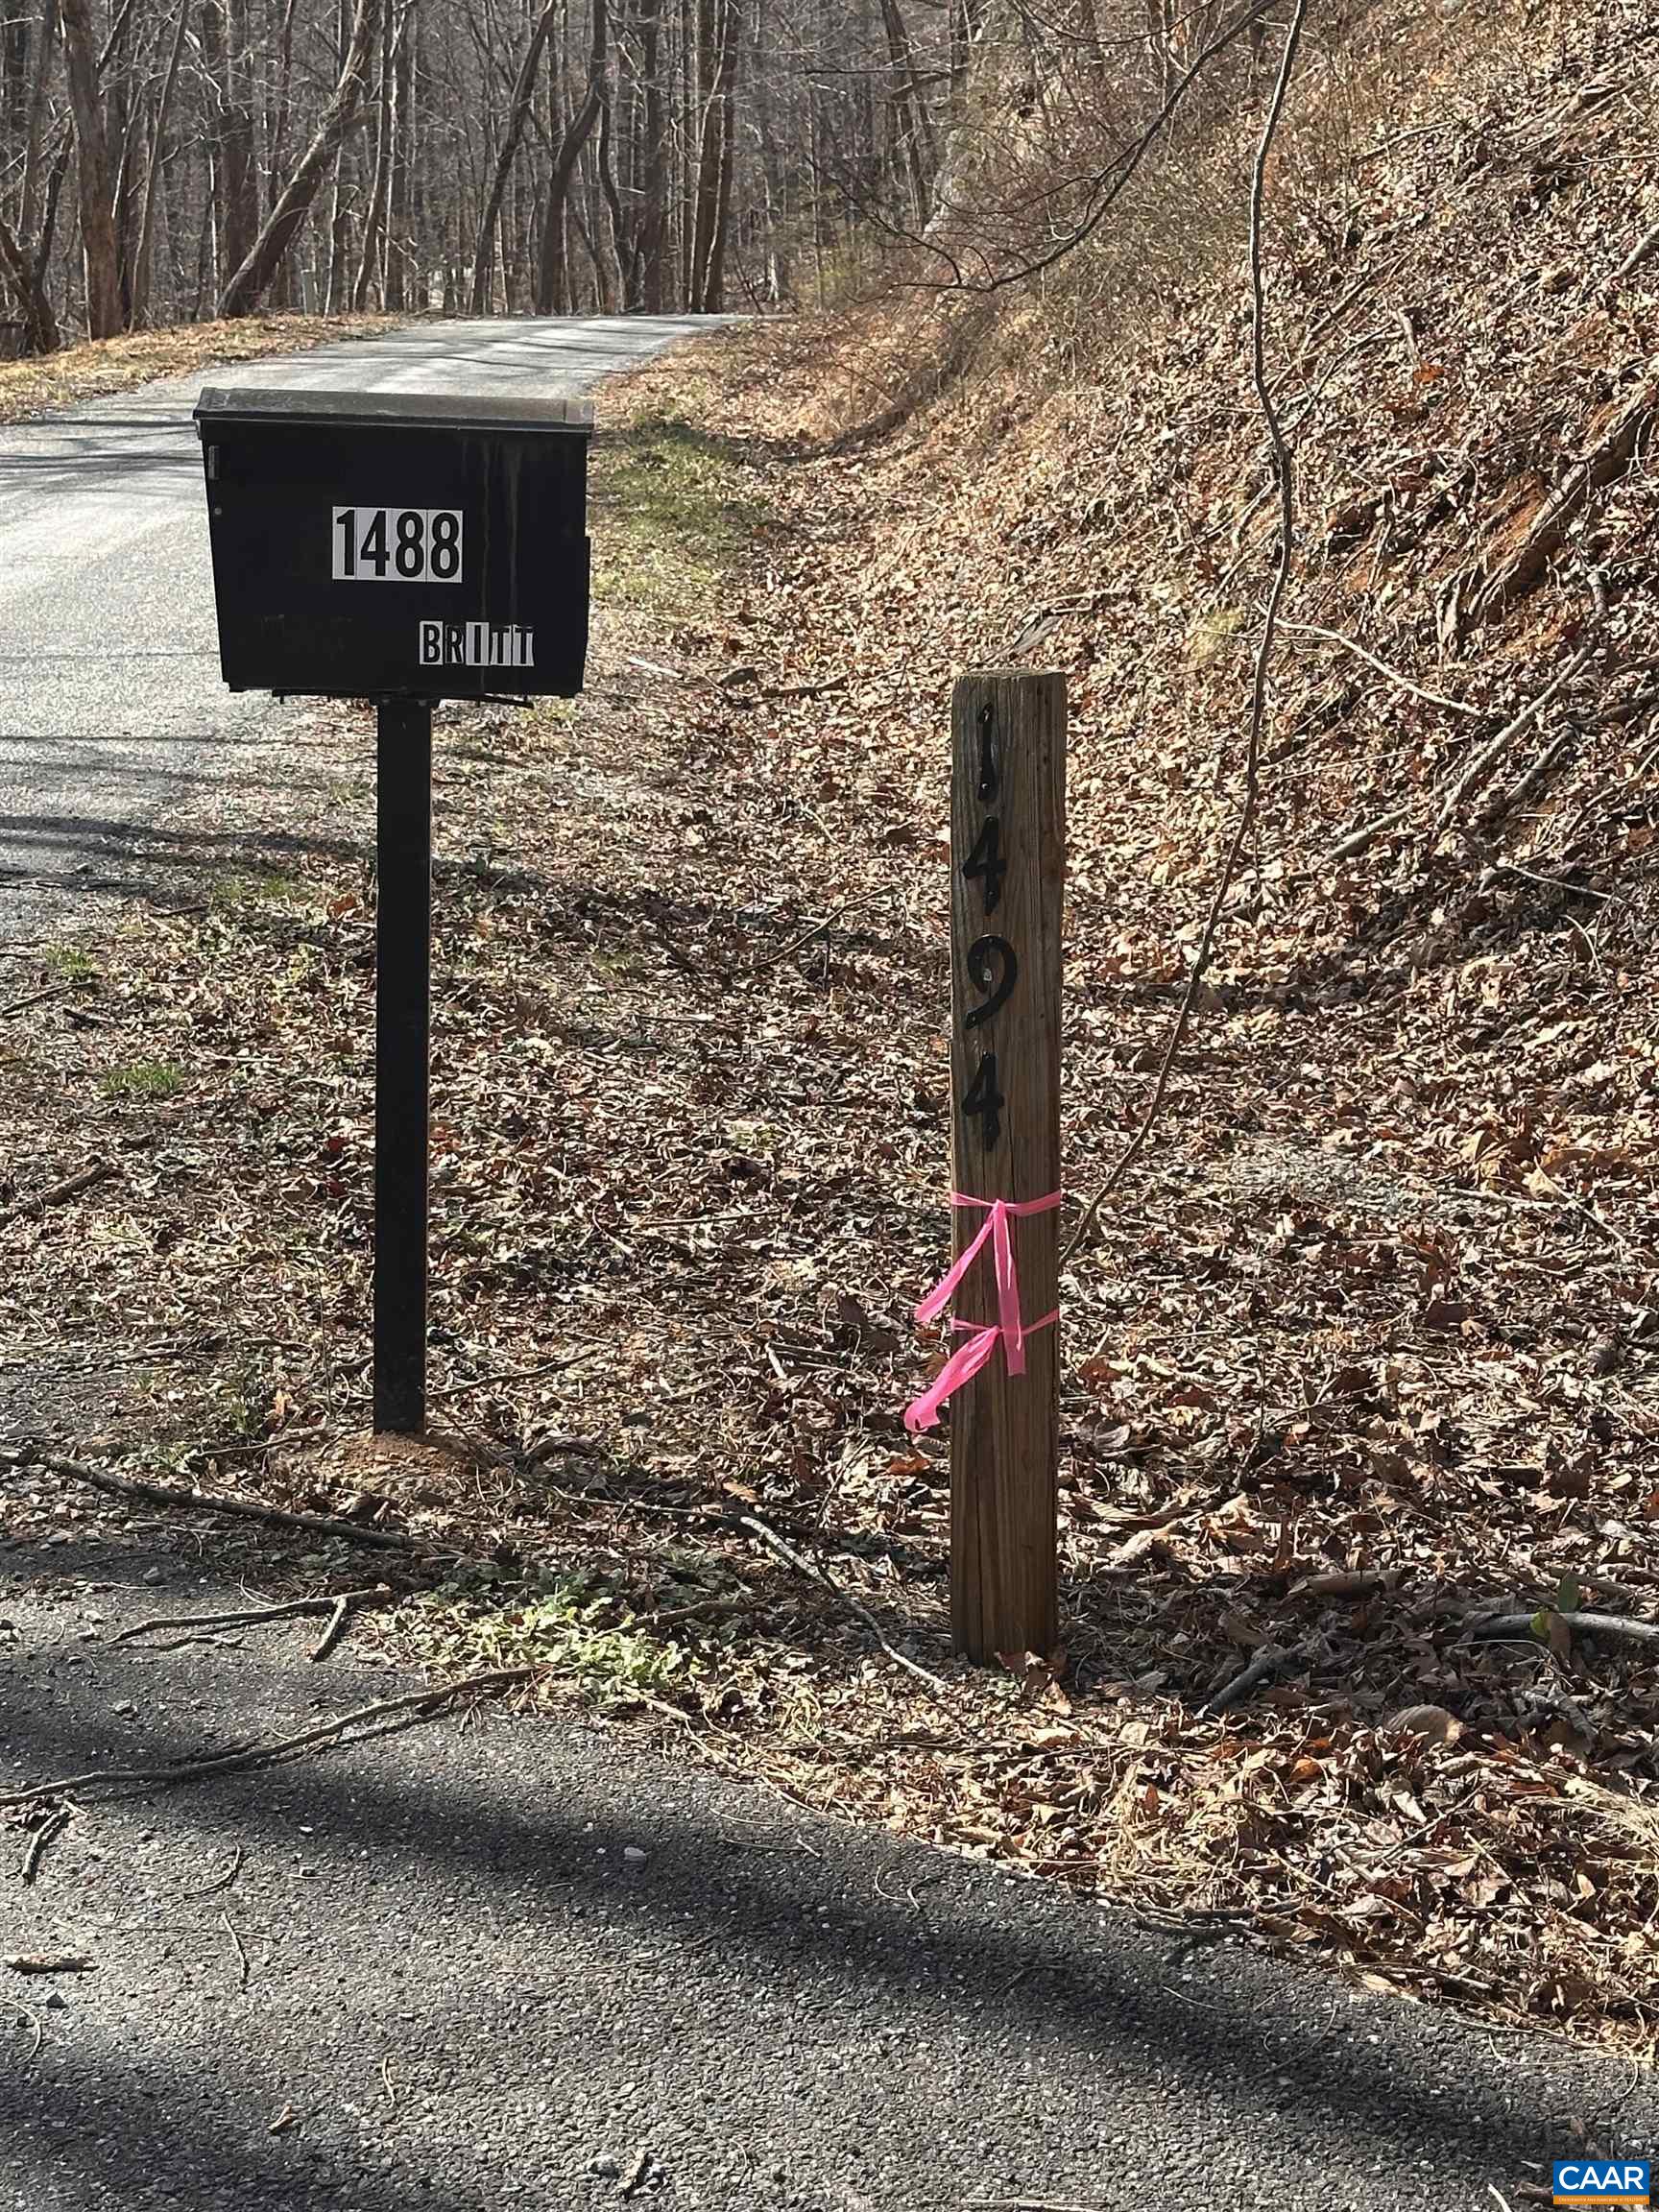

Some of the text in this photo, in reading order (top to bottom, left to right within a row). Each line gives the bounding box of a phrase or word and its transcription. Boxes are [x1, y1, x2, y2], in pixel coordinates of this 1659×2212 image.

[336, 509, 460, 578] 1488
[422, 623, 534, 664] BRITT
[962, 702, 1018, 1152] 1494
